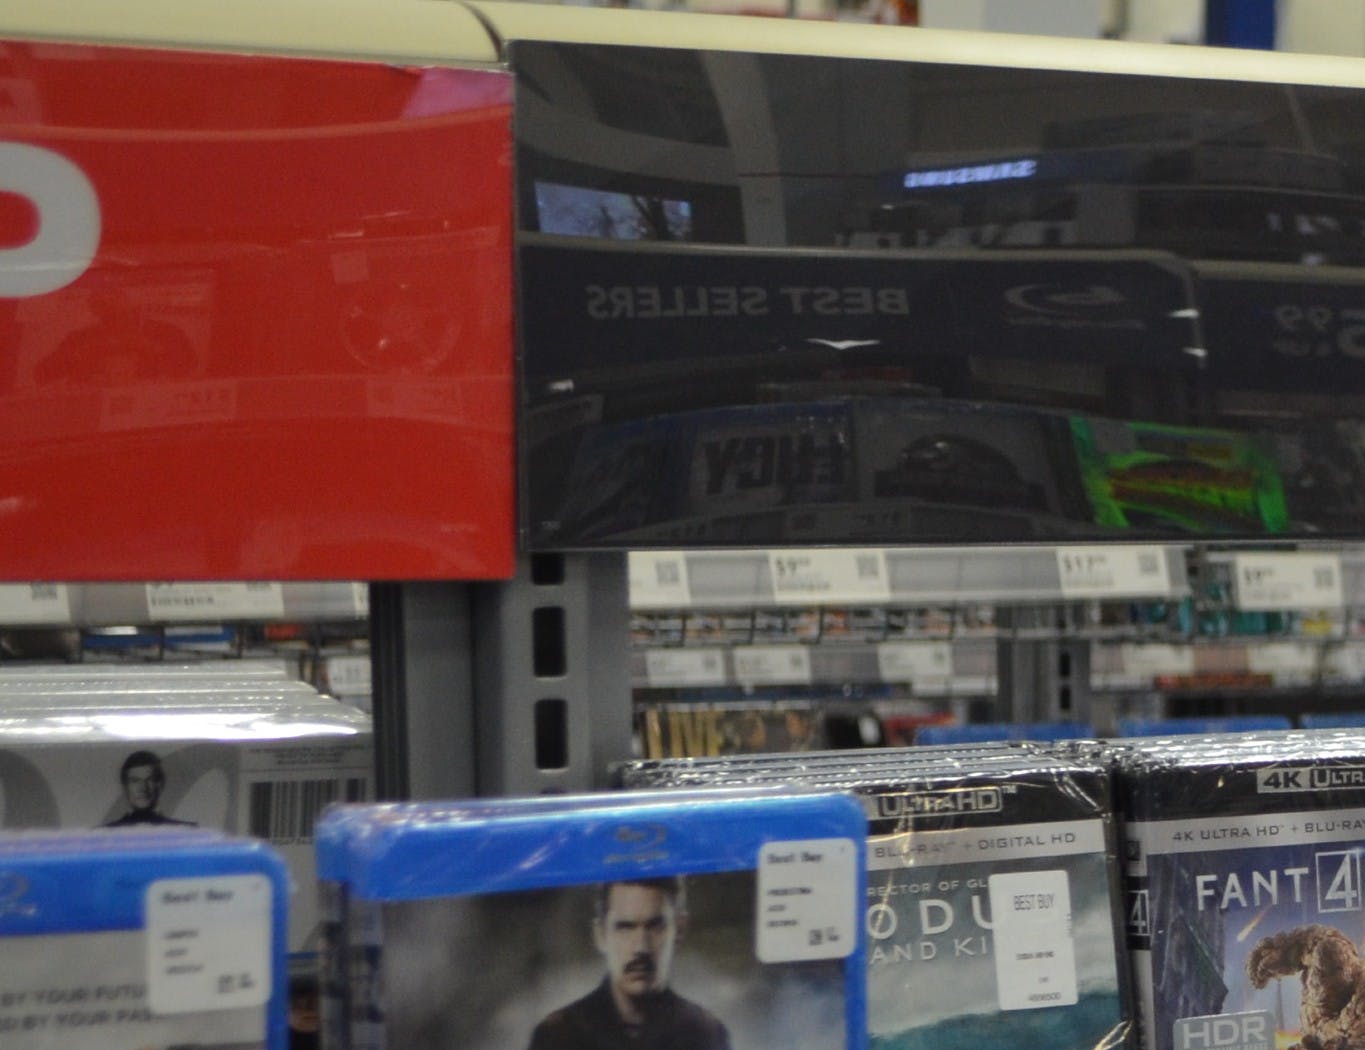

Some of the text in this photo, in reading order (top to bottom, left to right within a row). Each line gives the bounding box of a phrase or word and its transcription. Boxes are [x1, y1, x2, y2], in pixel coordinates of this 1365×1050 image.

[1263, 768, 1300, 789] 4K
[978, 834, 1045, 850] DIGITAL
[1051, 832, 1076, 845] HD
[1172, 830, 1194, 842] 4K
[1200, 826, 1250, 841] ULTRA
[1256, 823, 1280, 838] HD
[938, 879, 960, 892] OF
[866, 894, 994, 940] ODU
[869, 935, 988, 966] AND KI
[1182, 1015, 1268, 1050] HDR
